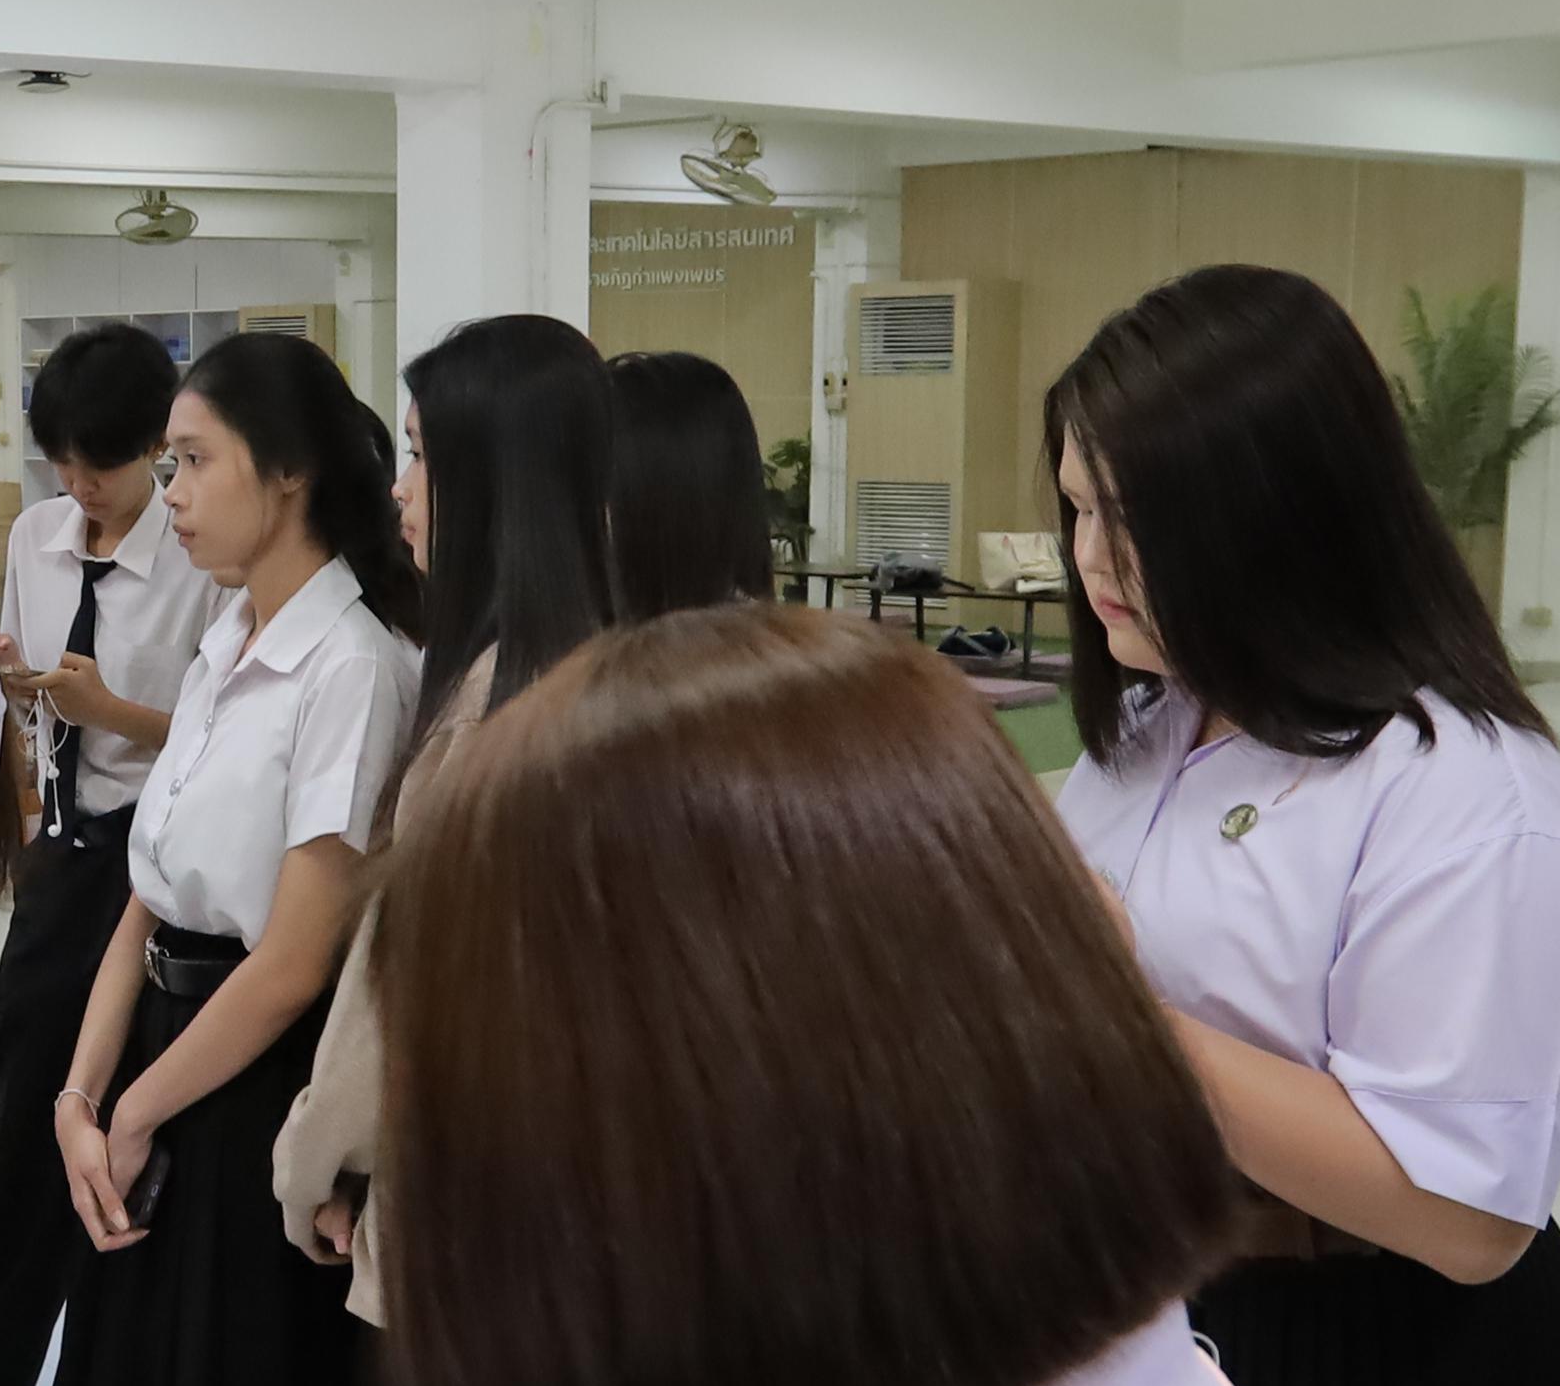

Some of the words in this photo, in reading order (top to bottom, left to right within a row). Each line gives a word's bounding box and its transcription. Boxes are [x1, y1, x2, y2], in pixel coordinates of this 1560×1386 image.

[590, 267, 726, 291] าชภัฏกำแพงเพชร
